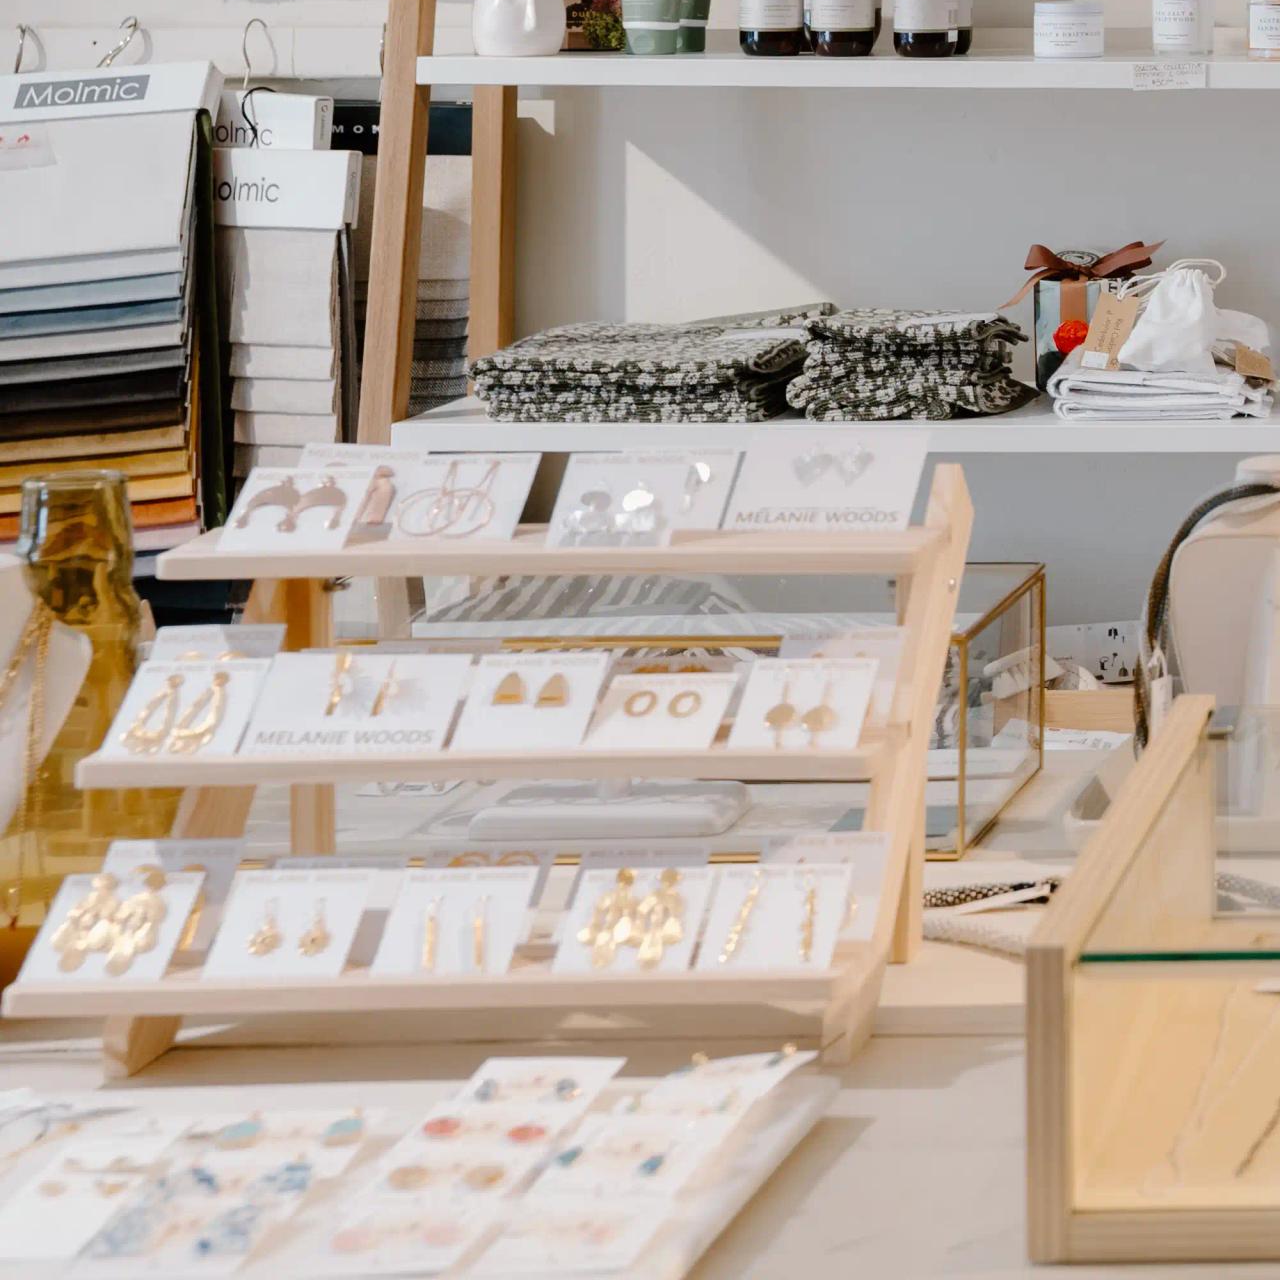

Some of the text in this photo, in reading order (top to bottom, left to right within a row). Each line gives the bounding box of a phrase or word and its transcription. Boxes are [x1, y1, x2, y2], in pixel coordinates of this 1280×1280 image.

[22, 78, 140, 107] Molmic
[213, 121, 274, 146] olmic
[213, 177, 280, 202] olmic
[735, 510, 900, 524] MELANIE WOODS
[254, 728, 434, 746] MELANIE WOODS
